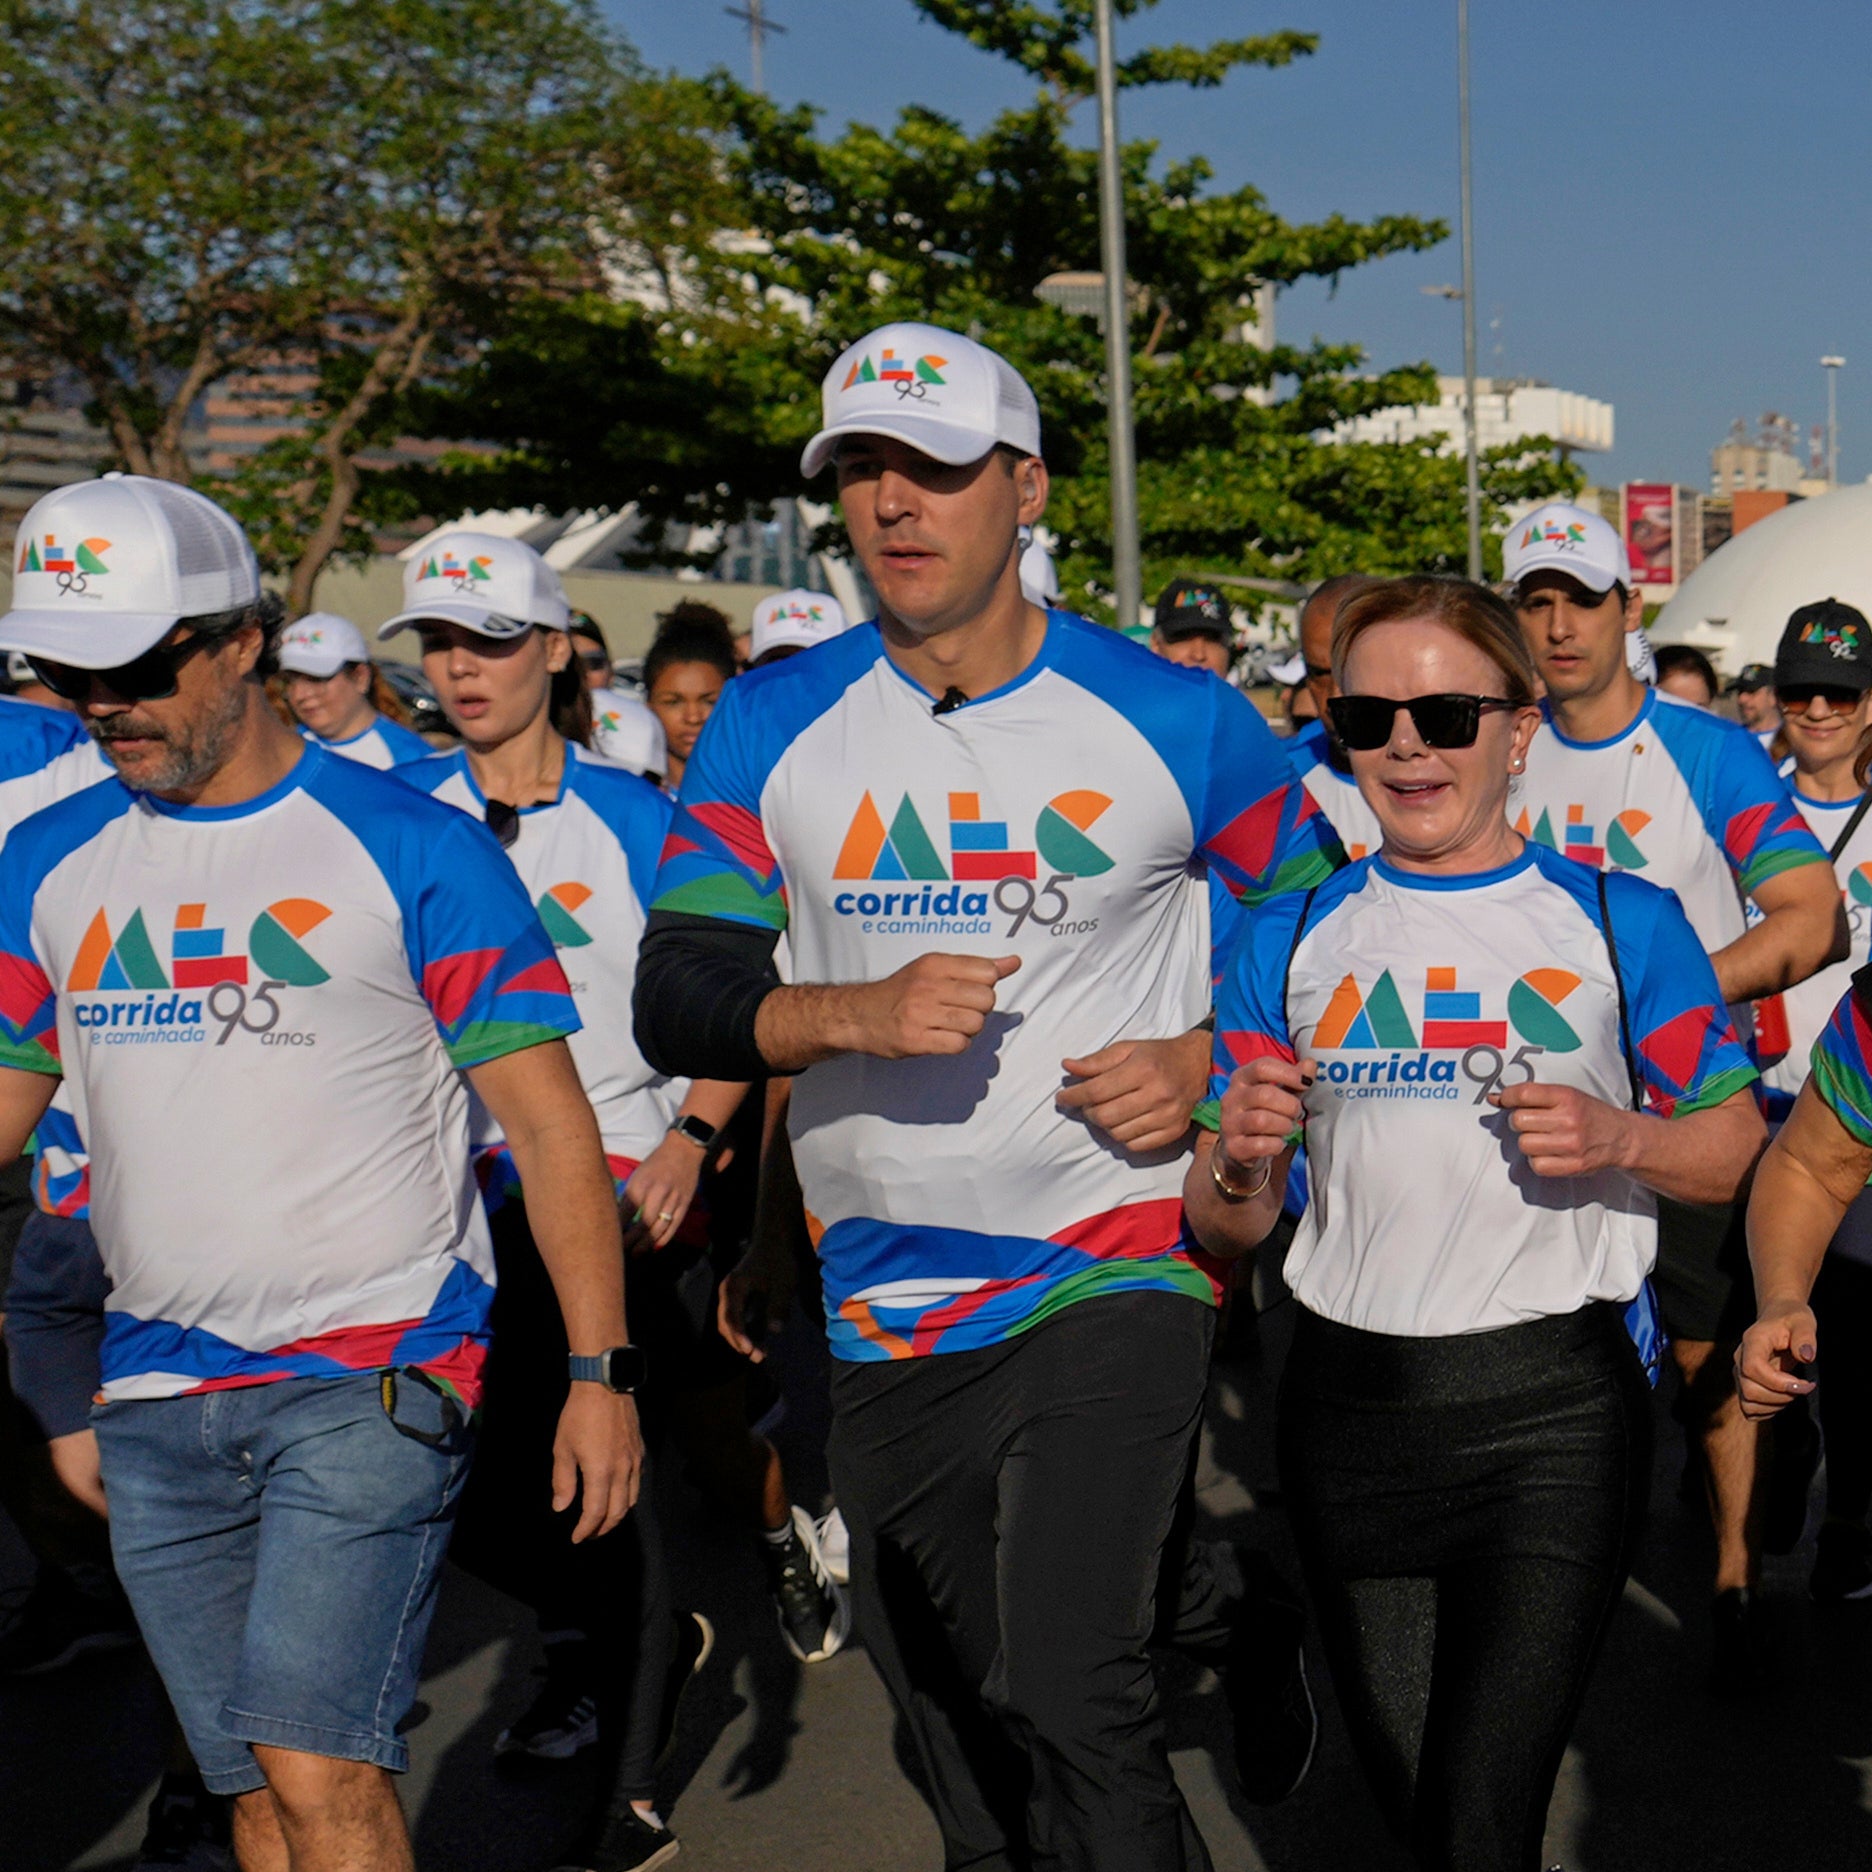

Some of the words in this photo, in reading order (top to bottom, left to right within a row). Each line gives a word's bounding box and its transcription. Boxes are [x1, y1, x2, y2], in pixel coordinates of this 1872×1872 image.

[56, 570, 90, 597] 95
[832, 789, 1116, 881] MEC
[834, 885, 988, 917] corrida
[993, 873, 1075, 939] 95
[861, 921, 874, 934] e
[876, 917, 992, 935] caminhada
[1049, 918, 1100, 937] anos
[67, 897, 334, 990] MEC
[76, 992, 202, 1029] corrida
[207, 979, 287, 1045] 95
[1310, 967, 1584, 1053] MEC
[91, 1032, 102, 1044] e
[105, 1026, 206, 1045] caminhada
[260, 1027, 316, 1047] anos
[1315, 1053, 1458, 1085] corrida
[1334, 1087, 1345, 1098] e
[1347, 1083, 1459, 1101] caminhada
